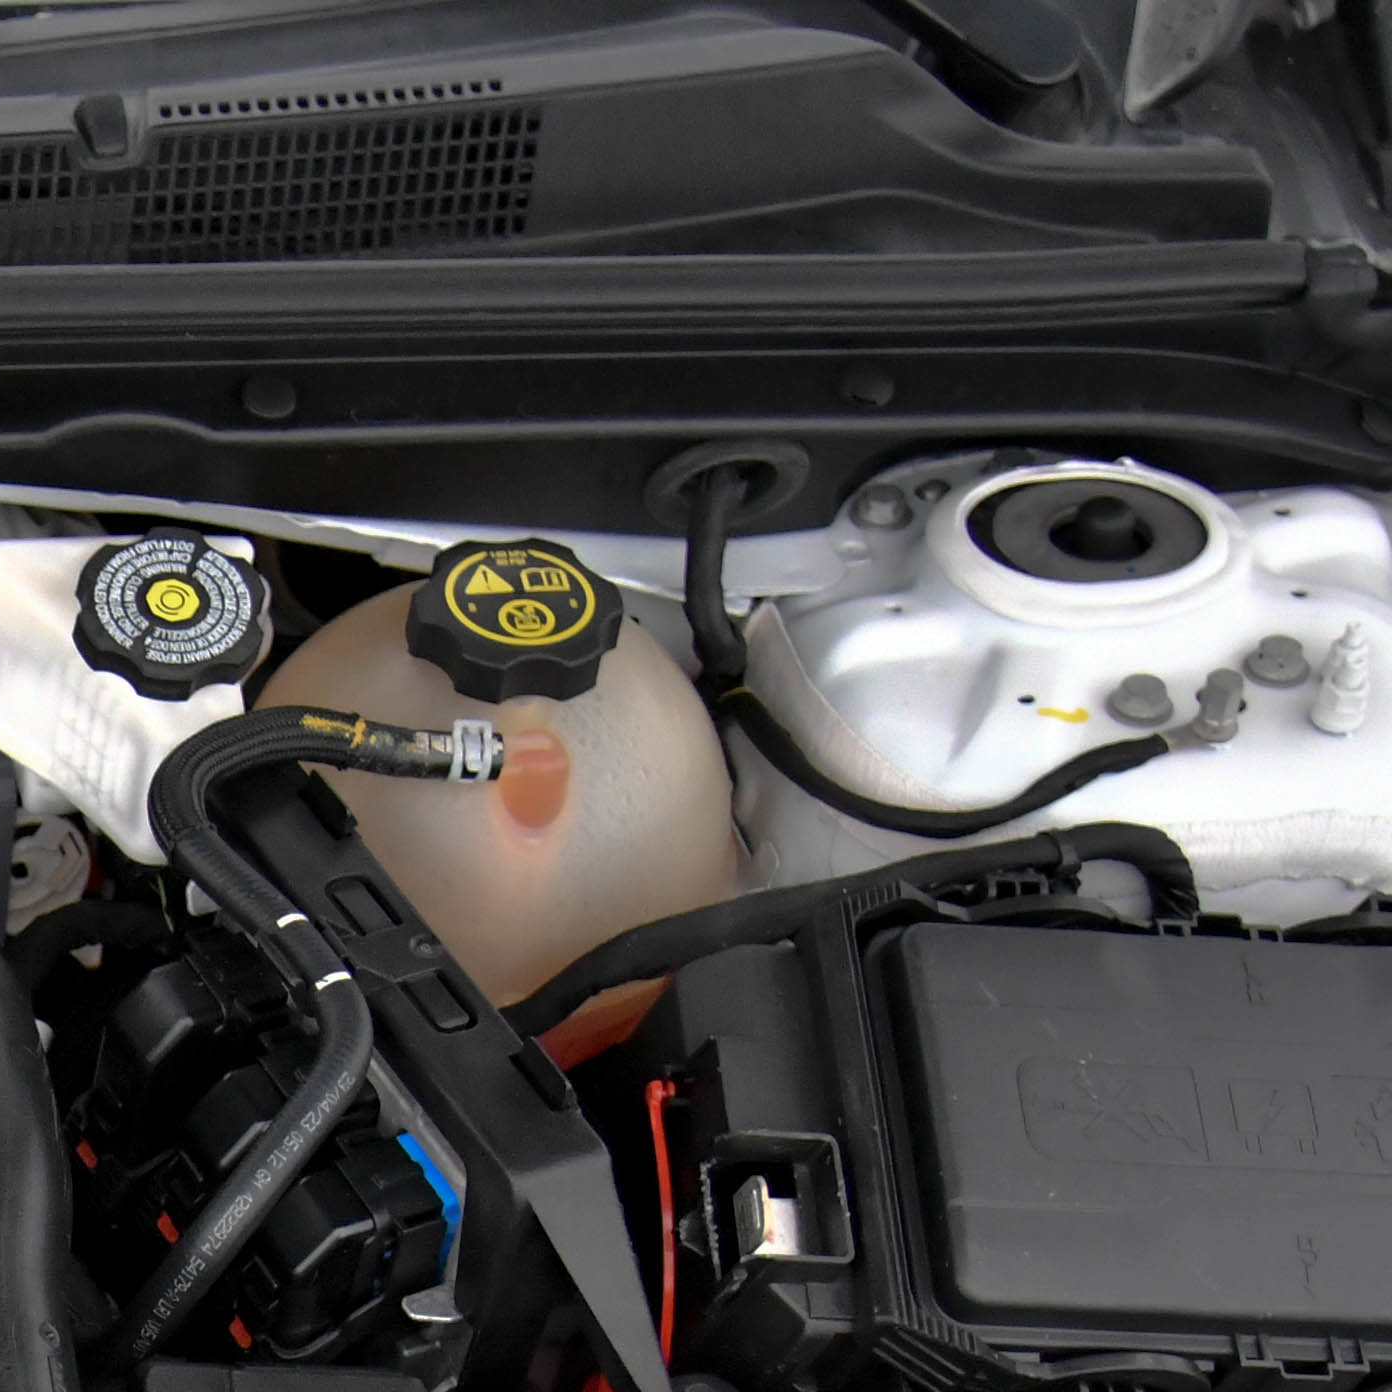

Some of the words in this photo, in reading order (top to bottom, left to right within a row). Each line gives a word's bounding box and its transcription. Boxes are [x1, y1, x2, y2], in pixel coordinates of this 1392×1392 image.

[132, 538, 164, 555] FLUID
[173, 539, 196, 552] DOT
[107, 546, 136, 569] FROM
[130, 549, 167, 569] BEFORE
[167, 550, 193, 563] CAP
[93, 570, 113, 602] SEALED
[169, 639, 198, 651] FREIN
[182, 647, 213, 663] AVANT
[266, 1130, 305, 1171] 05:12
